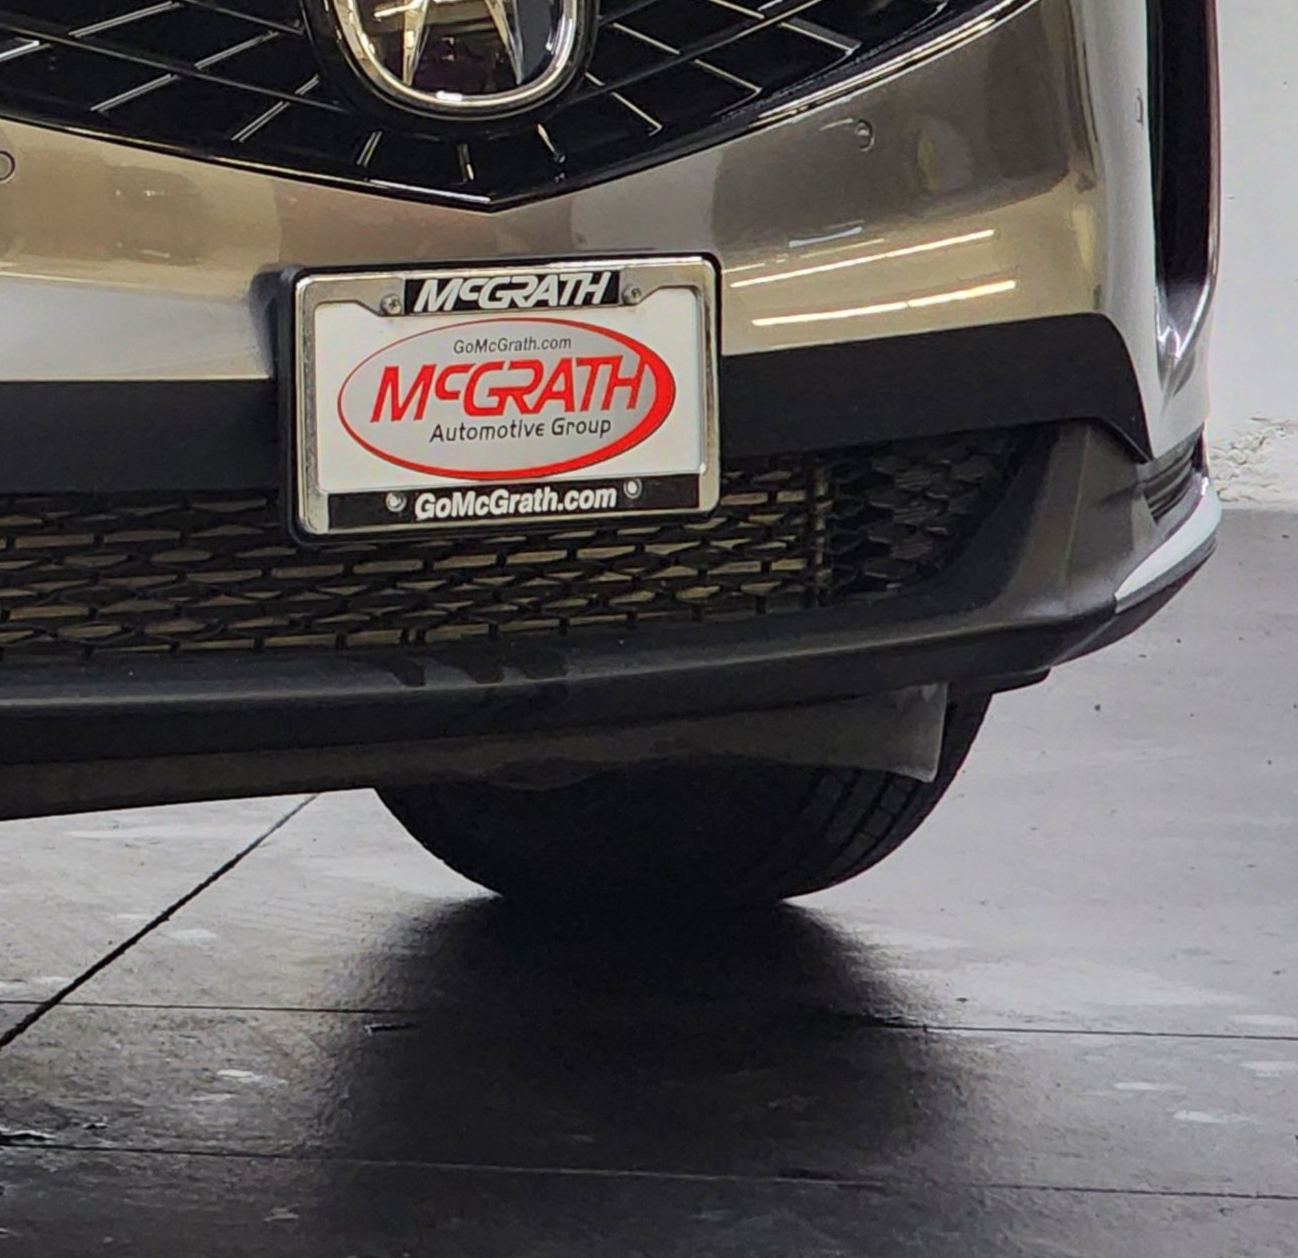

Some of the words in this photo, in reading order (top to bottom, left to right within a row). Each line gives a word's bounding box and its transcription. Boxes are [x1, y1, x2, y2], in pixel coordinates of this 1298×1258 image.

[413, 271, 612, 313] McGRATH
[453, 336, 572, 355] GoMcGrath.com
[371, 355, 646, 423] McGRATH
[429, 419, 545, 443] Automotive
[551, 416, 612, 438] Group
[414, 486, 618, 521] GoMcGrath.com
